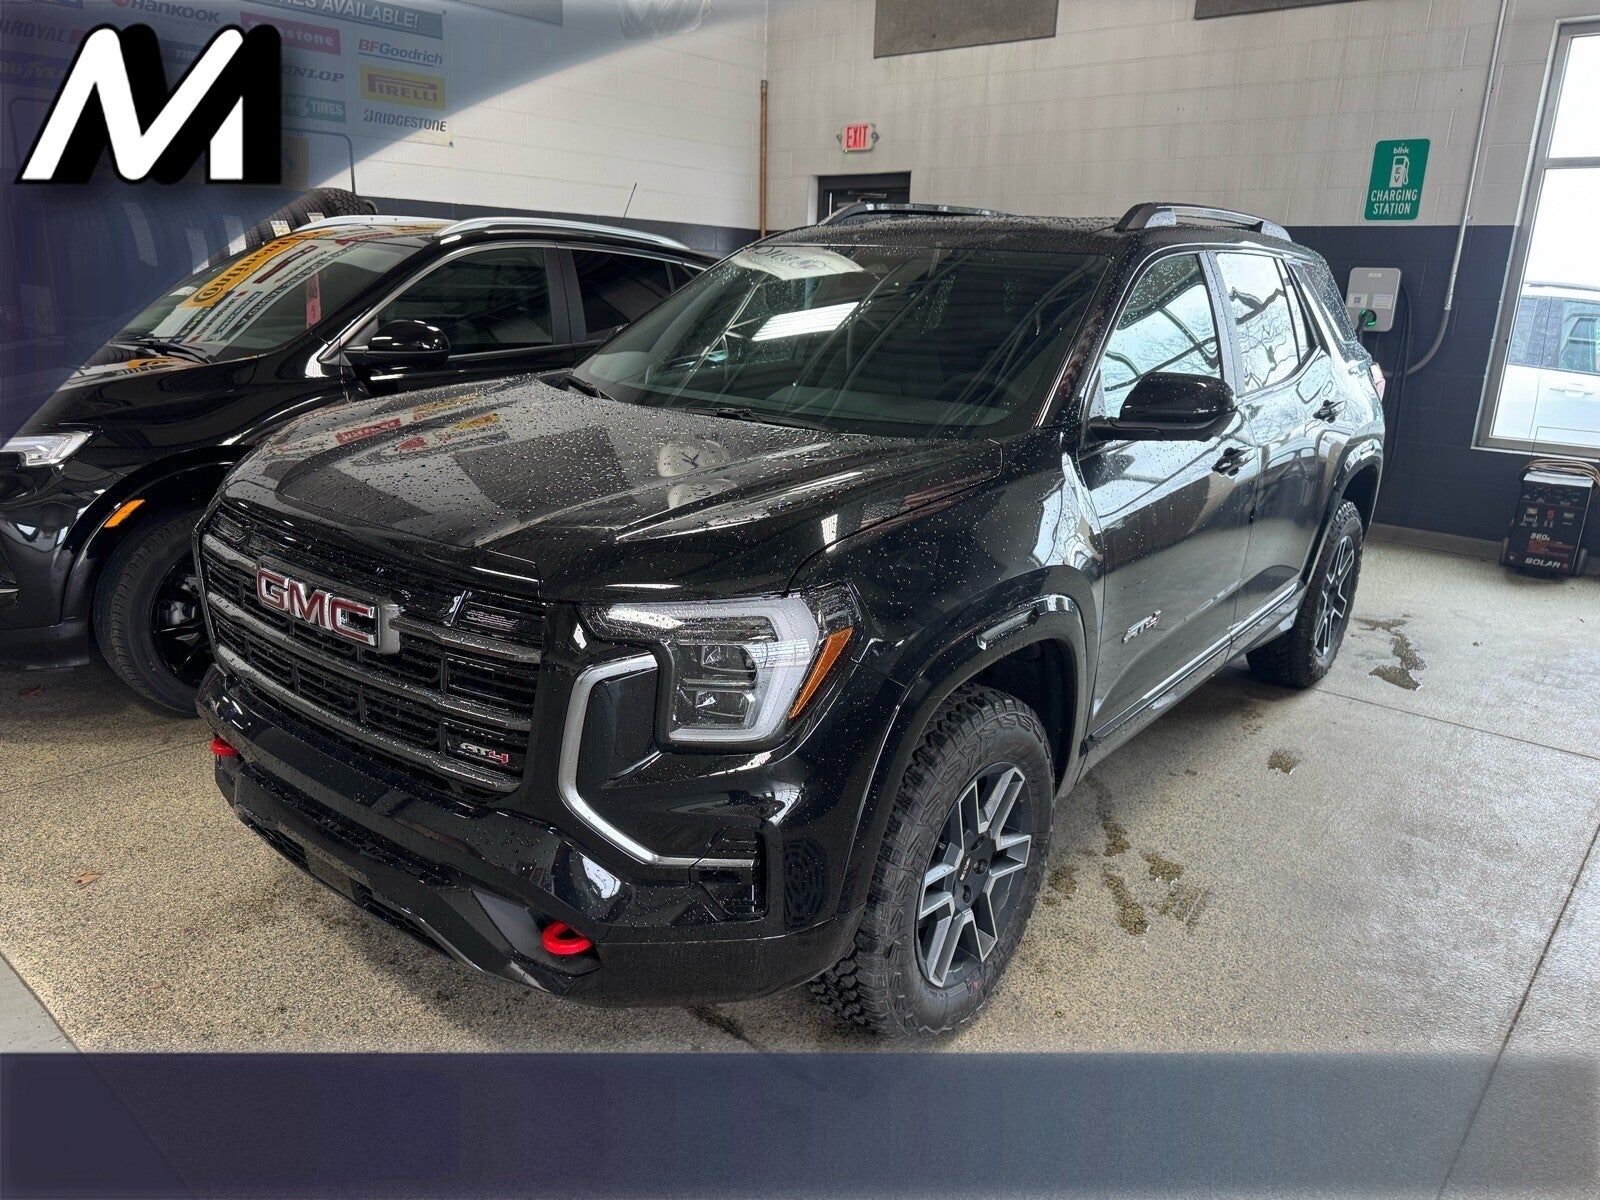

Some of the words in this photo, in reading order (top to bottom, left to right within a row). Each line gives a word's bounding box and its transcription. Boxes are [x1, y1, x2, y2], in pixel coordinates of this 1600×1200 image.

[321, 0, 419, 29] AVAILABLE!
[358, 38, 443, 65] BFGoodrich
[367, 72, 439, 104] PIRELLI
[309, 100, 344, 117] TIRES
[363, 109, 447, 132] BRIDGESTONE
[846, 125, 868, 148] EXIT
[1371, 189, 1418, 201] CHARGING
[1373, 203, 1411, 215] STATION
[256, 567, 377, 646] GMC
